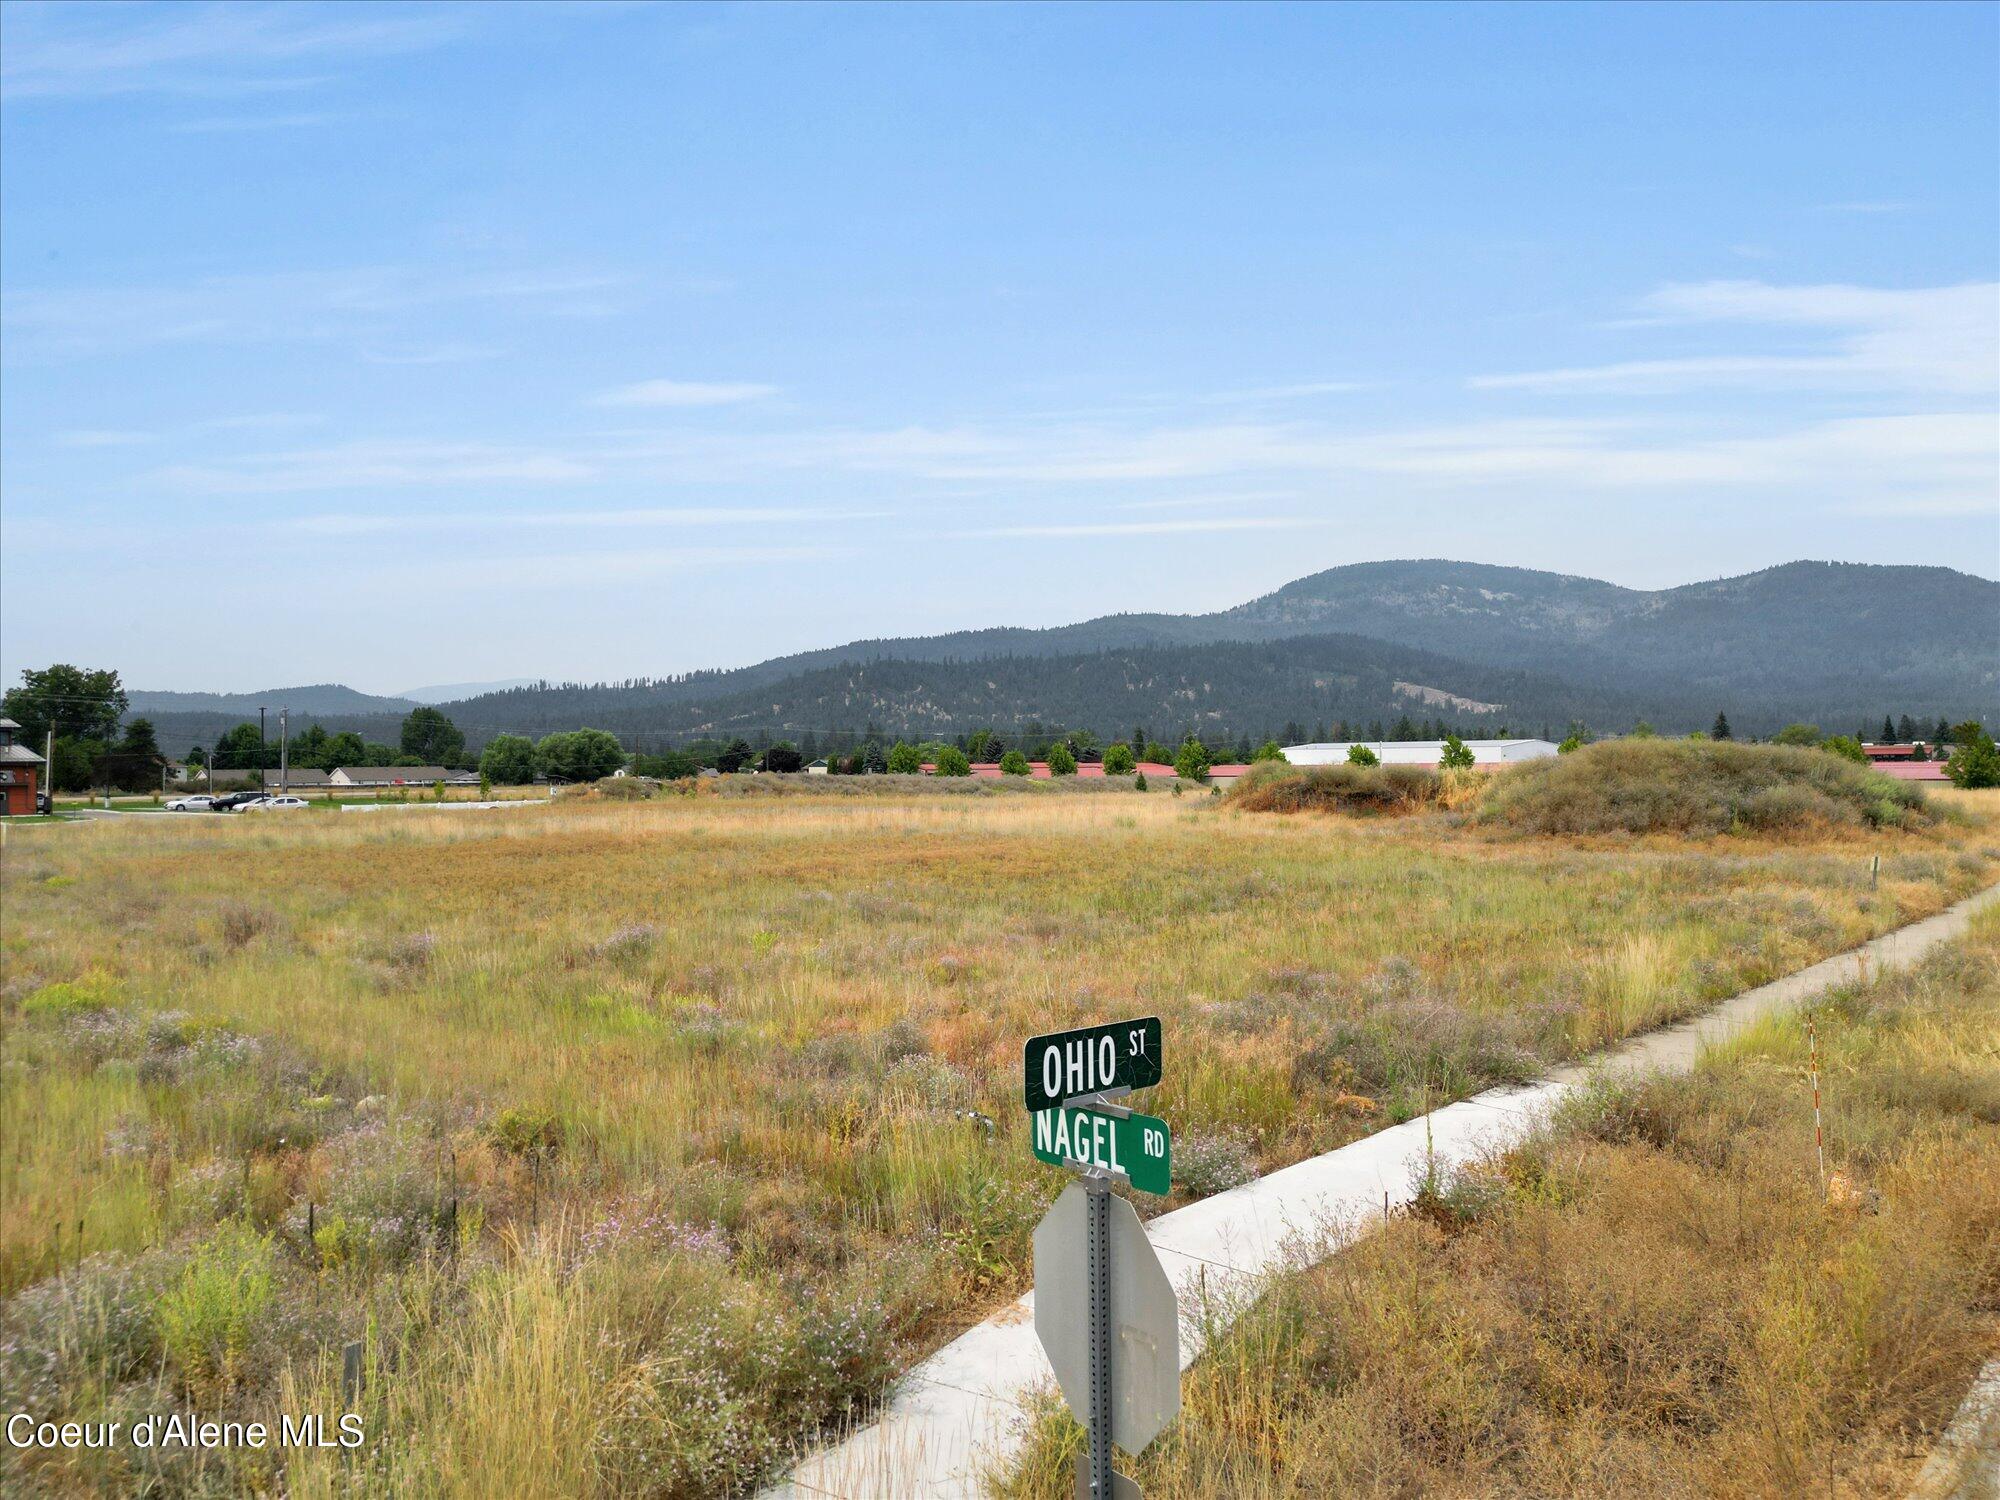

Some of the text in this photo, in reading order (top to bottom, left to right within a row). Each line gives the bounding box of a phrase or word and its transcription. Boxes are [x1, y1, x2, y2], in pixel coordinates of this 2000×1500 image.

[1043, 1029, 1146, 1098] OHIO ST
[1036, 1109, 1164, 1174] NAGEL RD
